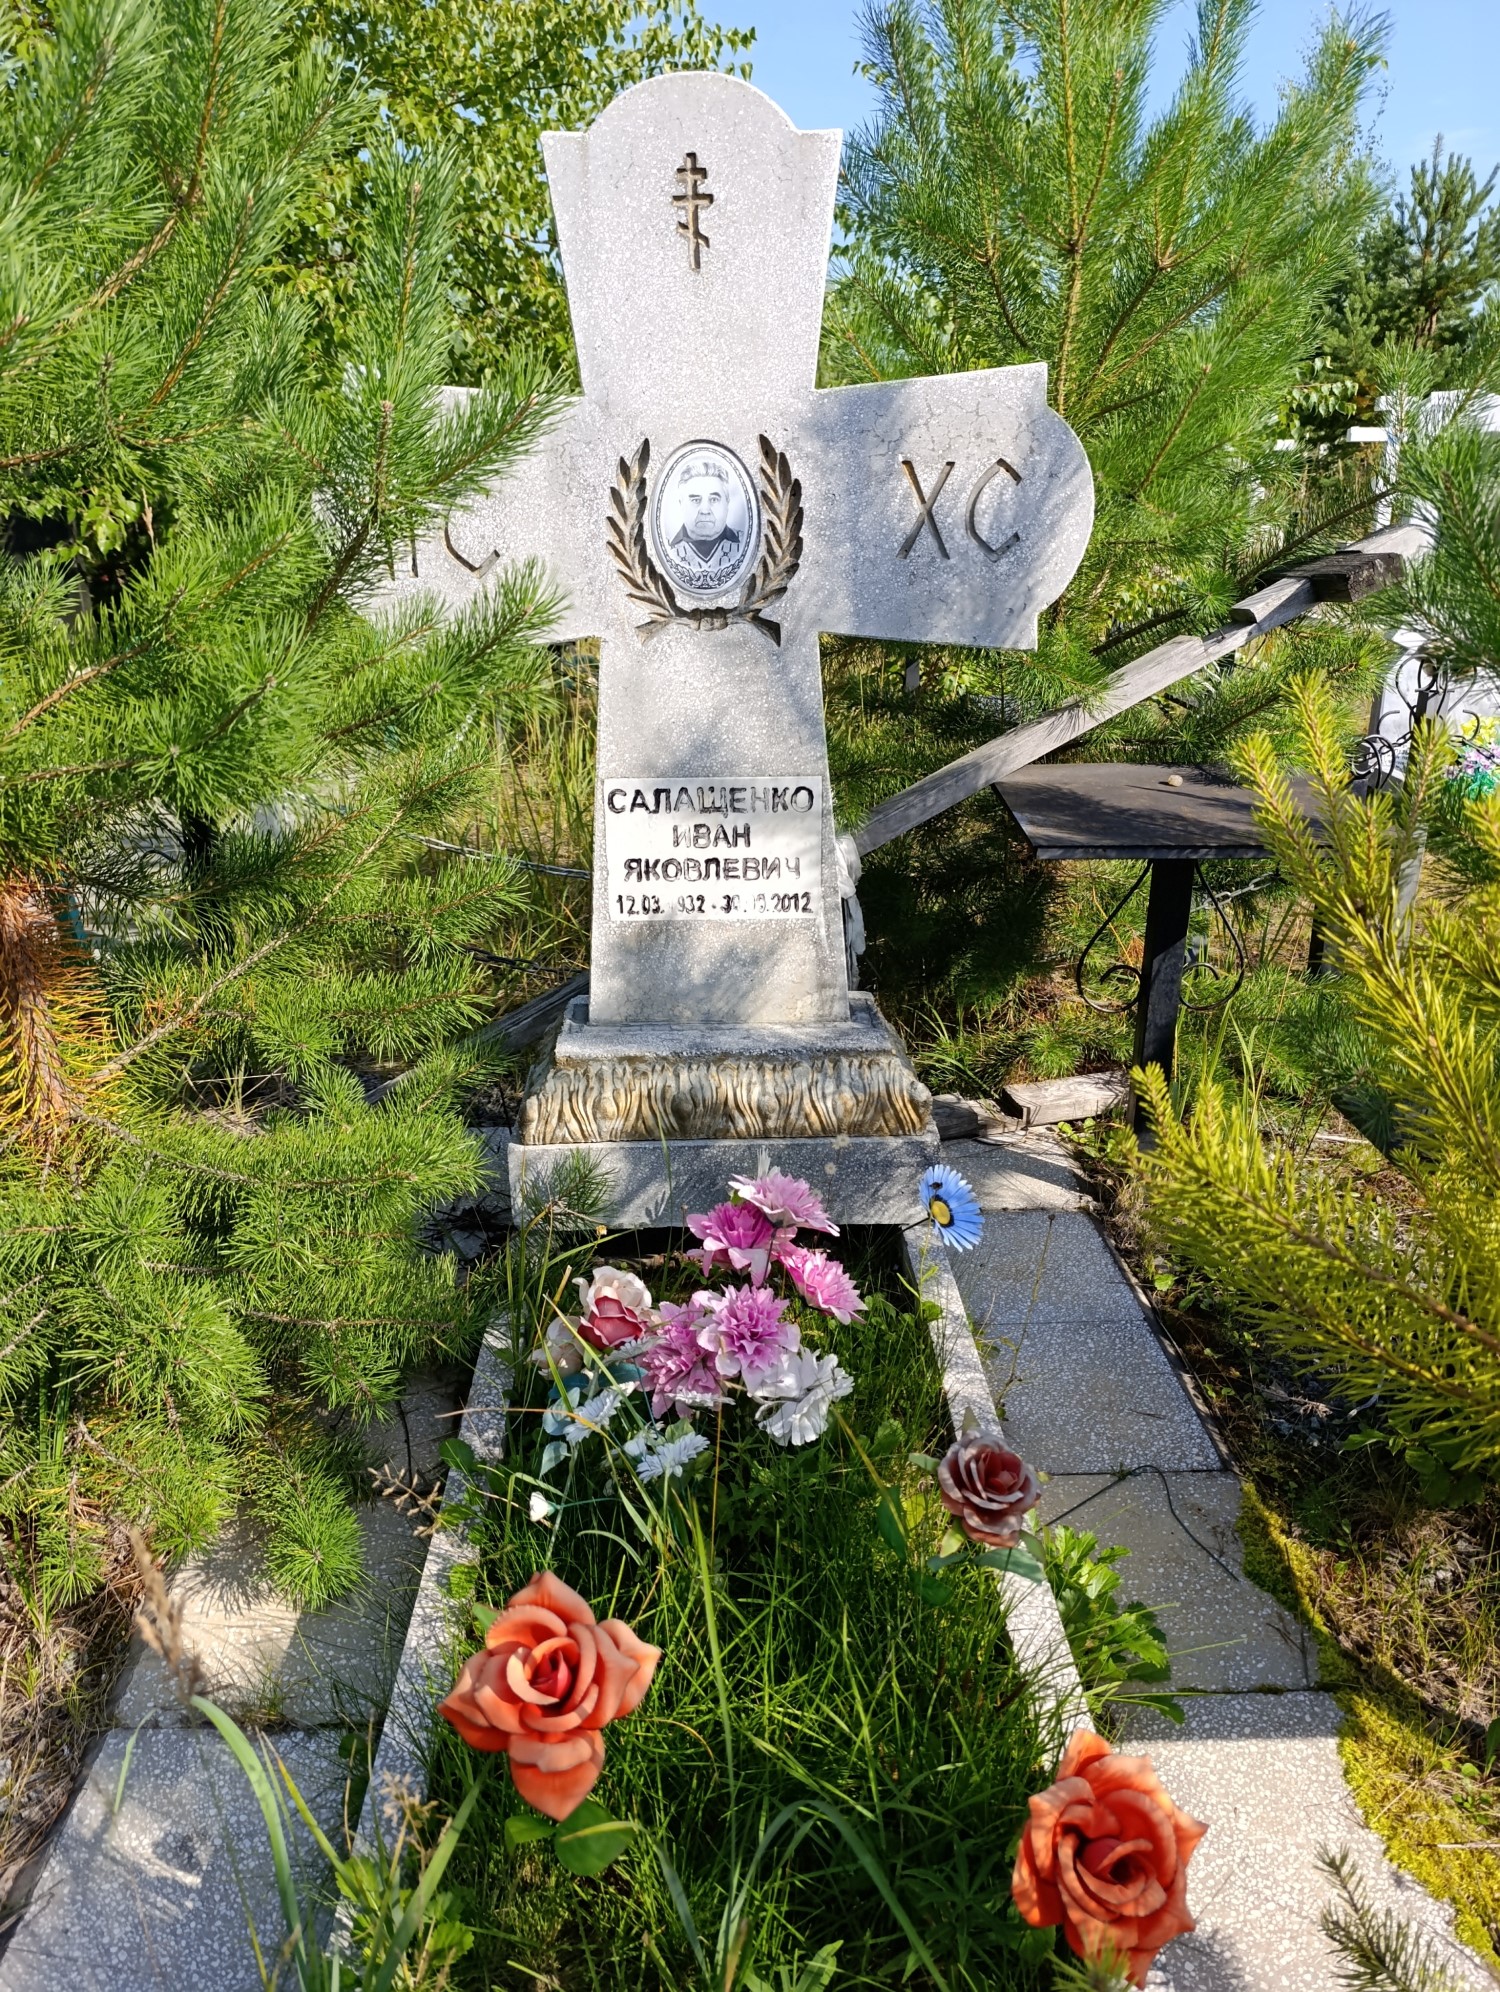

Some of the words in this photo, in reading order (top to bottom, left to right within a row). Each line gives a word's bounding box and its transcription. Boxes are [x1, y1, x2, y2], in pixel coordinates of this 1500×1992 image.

[896, 458, 1022, 563] ХС
[607, 786, 814, 818] САЛАЩЕНКО
[672, 822, 751, 848] ИВАН
[623, 856, 801, 882] ЯКОВЛЕВИЧ
